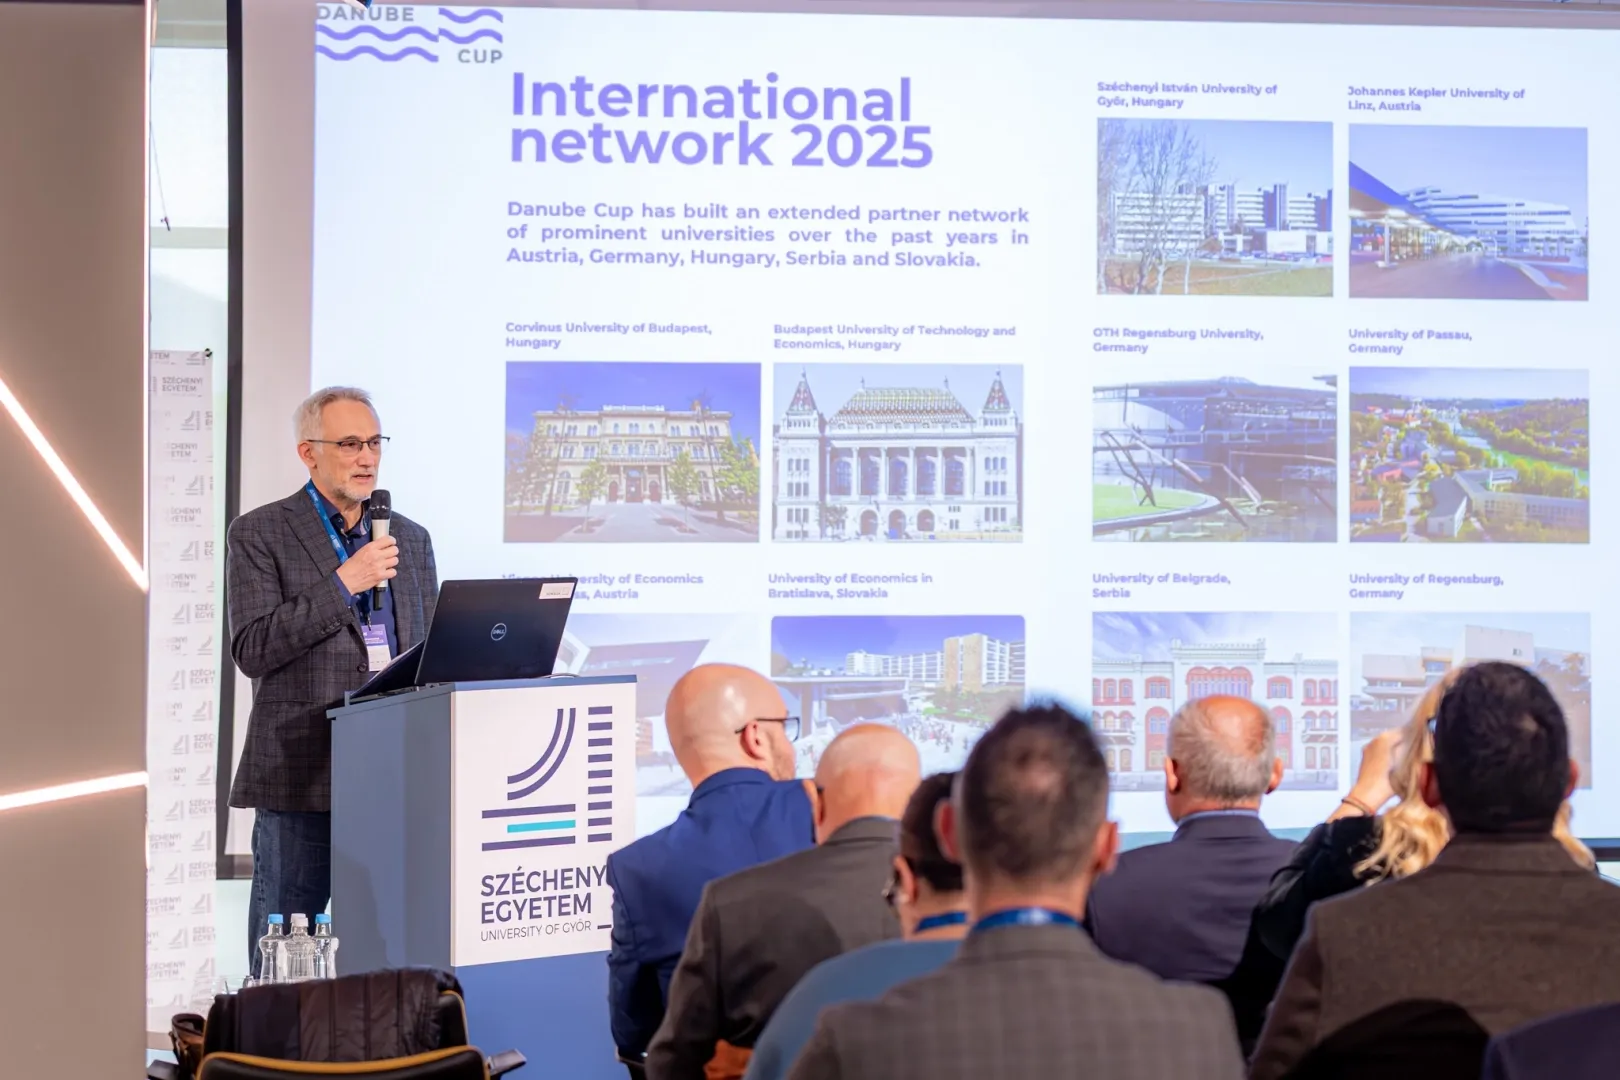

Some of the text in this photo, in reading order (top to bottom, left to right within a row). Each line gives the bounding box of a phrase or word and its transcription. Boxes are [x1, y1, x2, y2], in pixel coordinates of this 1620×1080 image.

[318, 6, 414, 21] DANUBE
[458, 49, 503, 63] CUP
[1097, 82, 1277, 96] Széchenyi István University of
[1348, 86, 1525, 100] Johannes Kepler University of
[513, 72, 910, 121] International
[1097, 96, 1184, 109] Győr, Hungary
[1348, 100, 1421, 112] Linz, Austria
[511, 120, 933, 168] network 2025
[508, 201, 1029, 224] Danube Cup has built an extended partner network
[507, 224, 1028, 247] of prominent universities over the past years in
[506, 247, 980, 268] Austria, Germany, Hungary, Serbia and Slovakia.
[506, 322, 712, 335] Corvinus University of Budapest,
[774, 324, 1016, 338] Budapest University of Technology and
[1093, 328, 1264, 341] OTH Regensburg University,
[1349, 329, 1472, 341] University of Passau,
[506, 338, 561, 349] Hungary
[774, 339, 901, 351] Economics, Hungary
[1093, 342, 1148, 354] Germany
[1348, 344, 1403, 355] Germany
[618, 574, 631, 584] of
[635, 573, 704, 584] Economics
[769, 573, 933, 585] University of Economics in
[1093, 573, 1231, 585] University of Belgrade,
[1350, 573, 1504, 586] University of Regensburg,
[593, 589, 638, 599] Austria
[768, 588, 888, 599] Bratislava, Slovakia
[1093, 588, 1130, 598] Serbia
[1349, 588, 1404, 600] Germany
[481, 865, 607, 897] SZÉCHENY
[481, 892, 591, 924] EGYETEM
[480, 918, 592, 941] UNIVERSITY OF GYŐR
